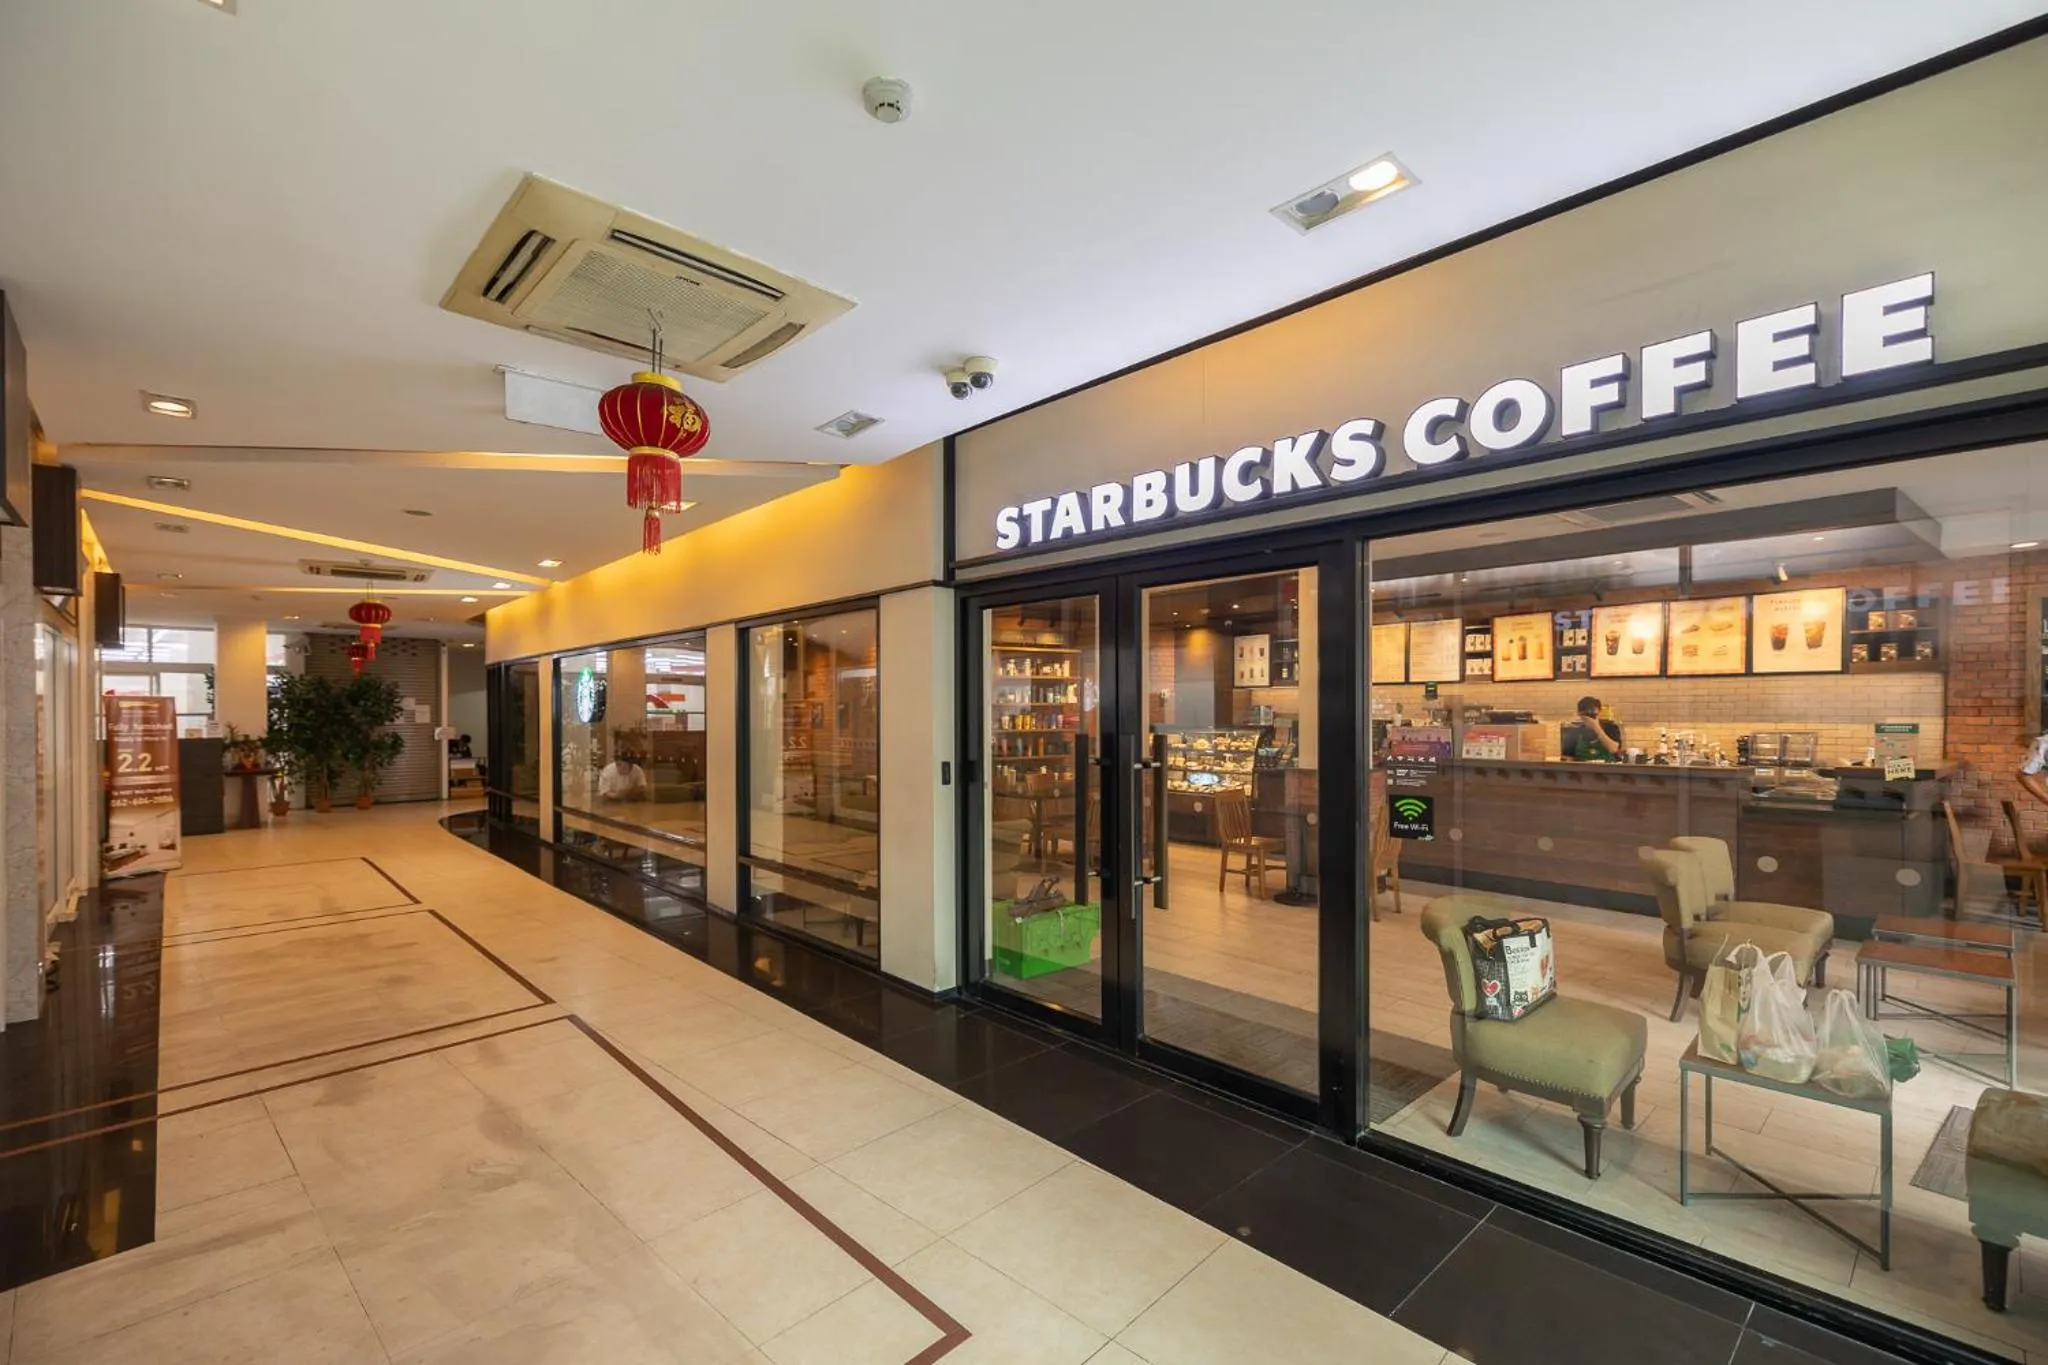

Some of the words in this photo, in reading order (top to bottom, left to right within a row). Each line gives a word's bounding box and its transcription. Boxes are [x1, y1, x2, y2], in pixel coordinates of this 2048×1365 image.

[996, 418, 1379, 549] STARBUCKS
[1402, 272, 1935, 465] COFFEE
[117, 752, 153, 773] 2.2
[1393, 821, 1409, 830] Free
[1409, 823, 1429, 831] Wi-Fi
